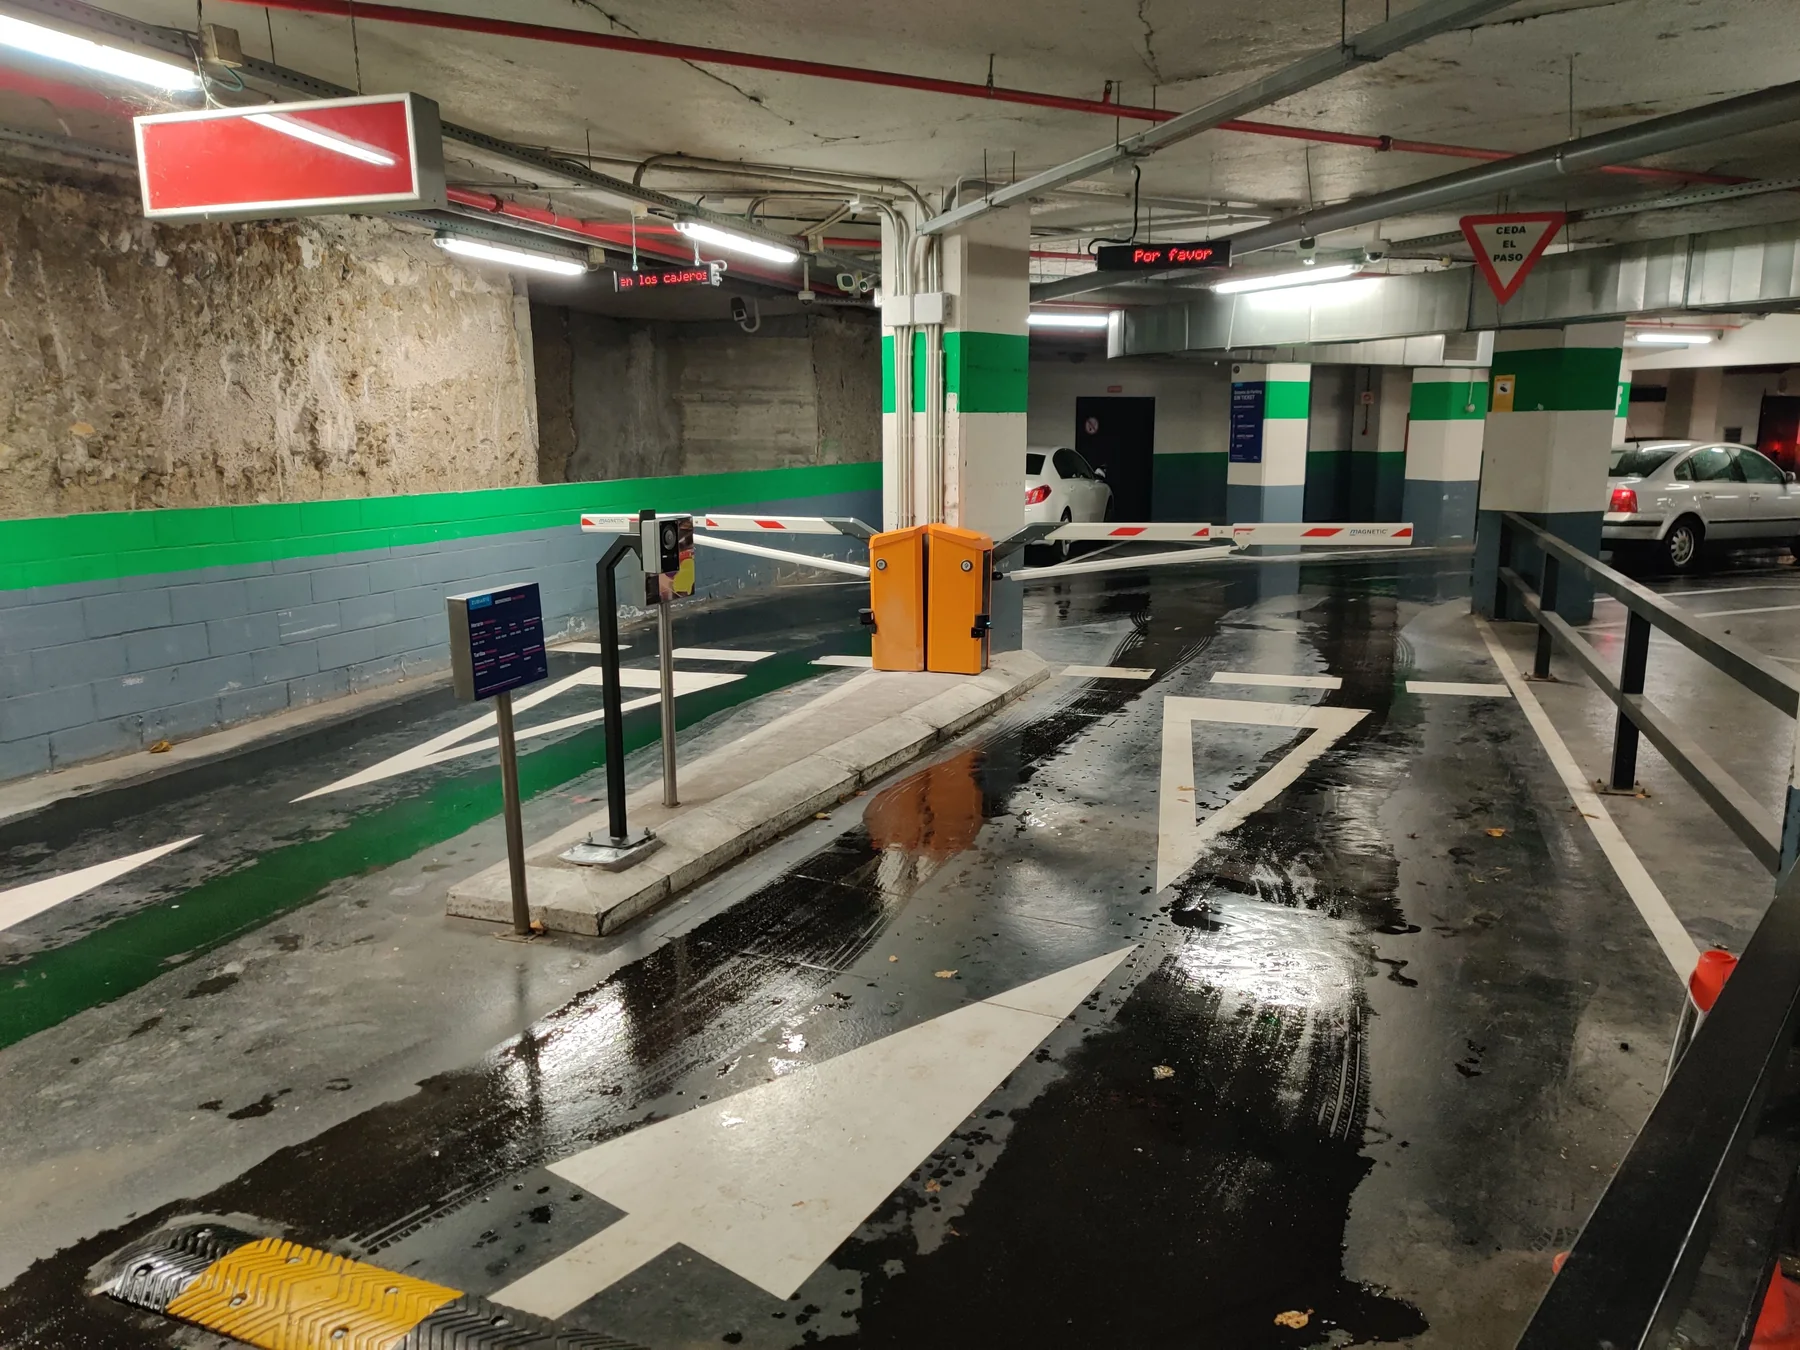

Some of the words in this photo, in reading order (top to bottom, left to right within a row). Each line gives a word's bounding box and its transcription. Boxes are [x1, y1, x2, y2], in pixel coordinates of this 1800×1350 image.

[1496, 226, 1526, 234] CEDA
[1503, 240, 1516, 248] EL
[1134, 250, 1161, 263] Por
[1168, 248, 1213, 261] favor
[1493, 254, 1523, 262] PASO
[620, 276, 633, 287] en
[639, 274, 658, 285] los
[663, 271, 707, 283] cajeros
